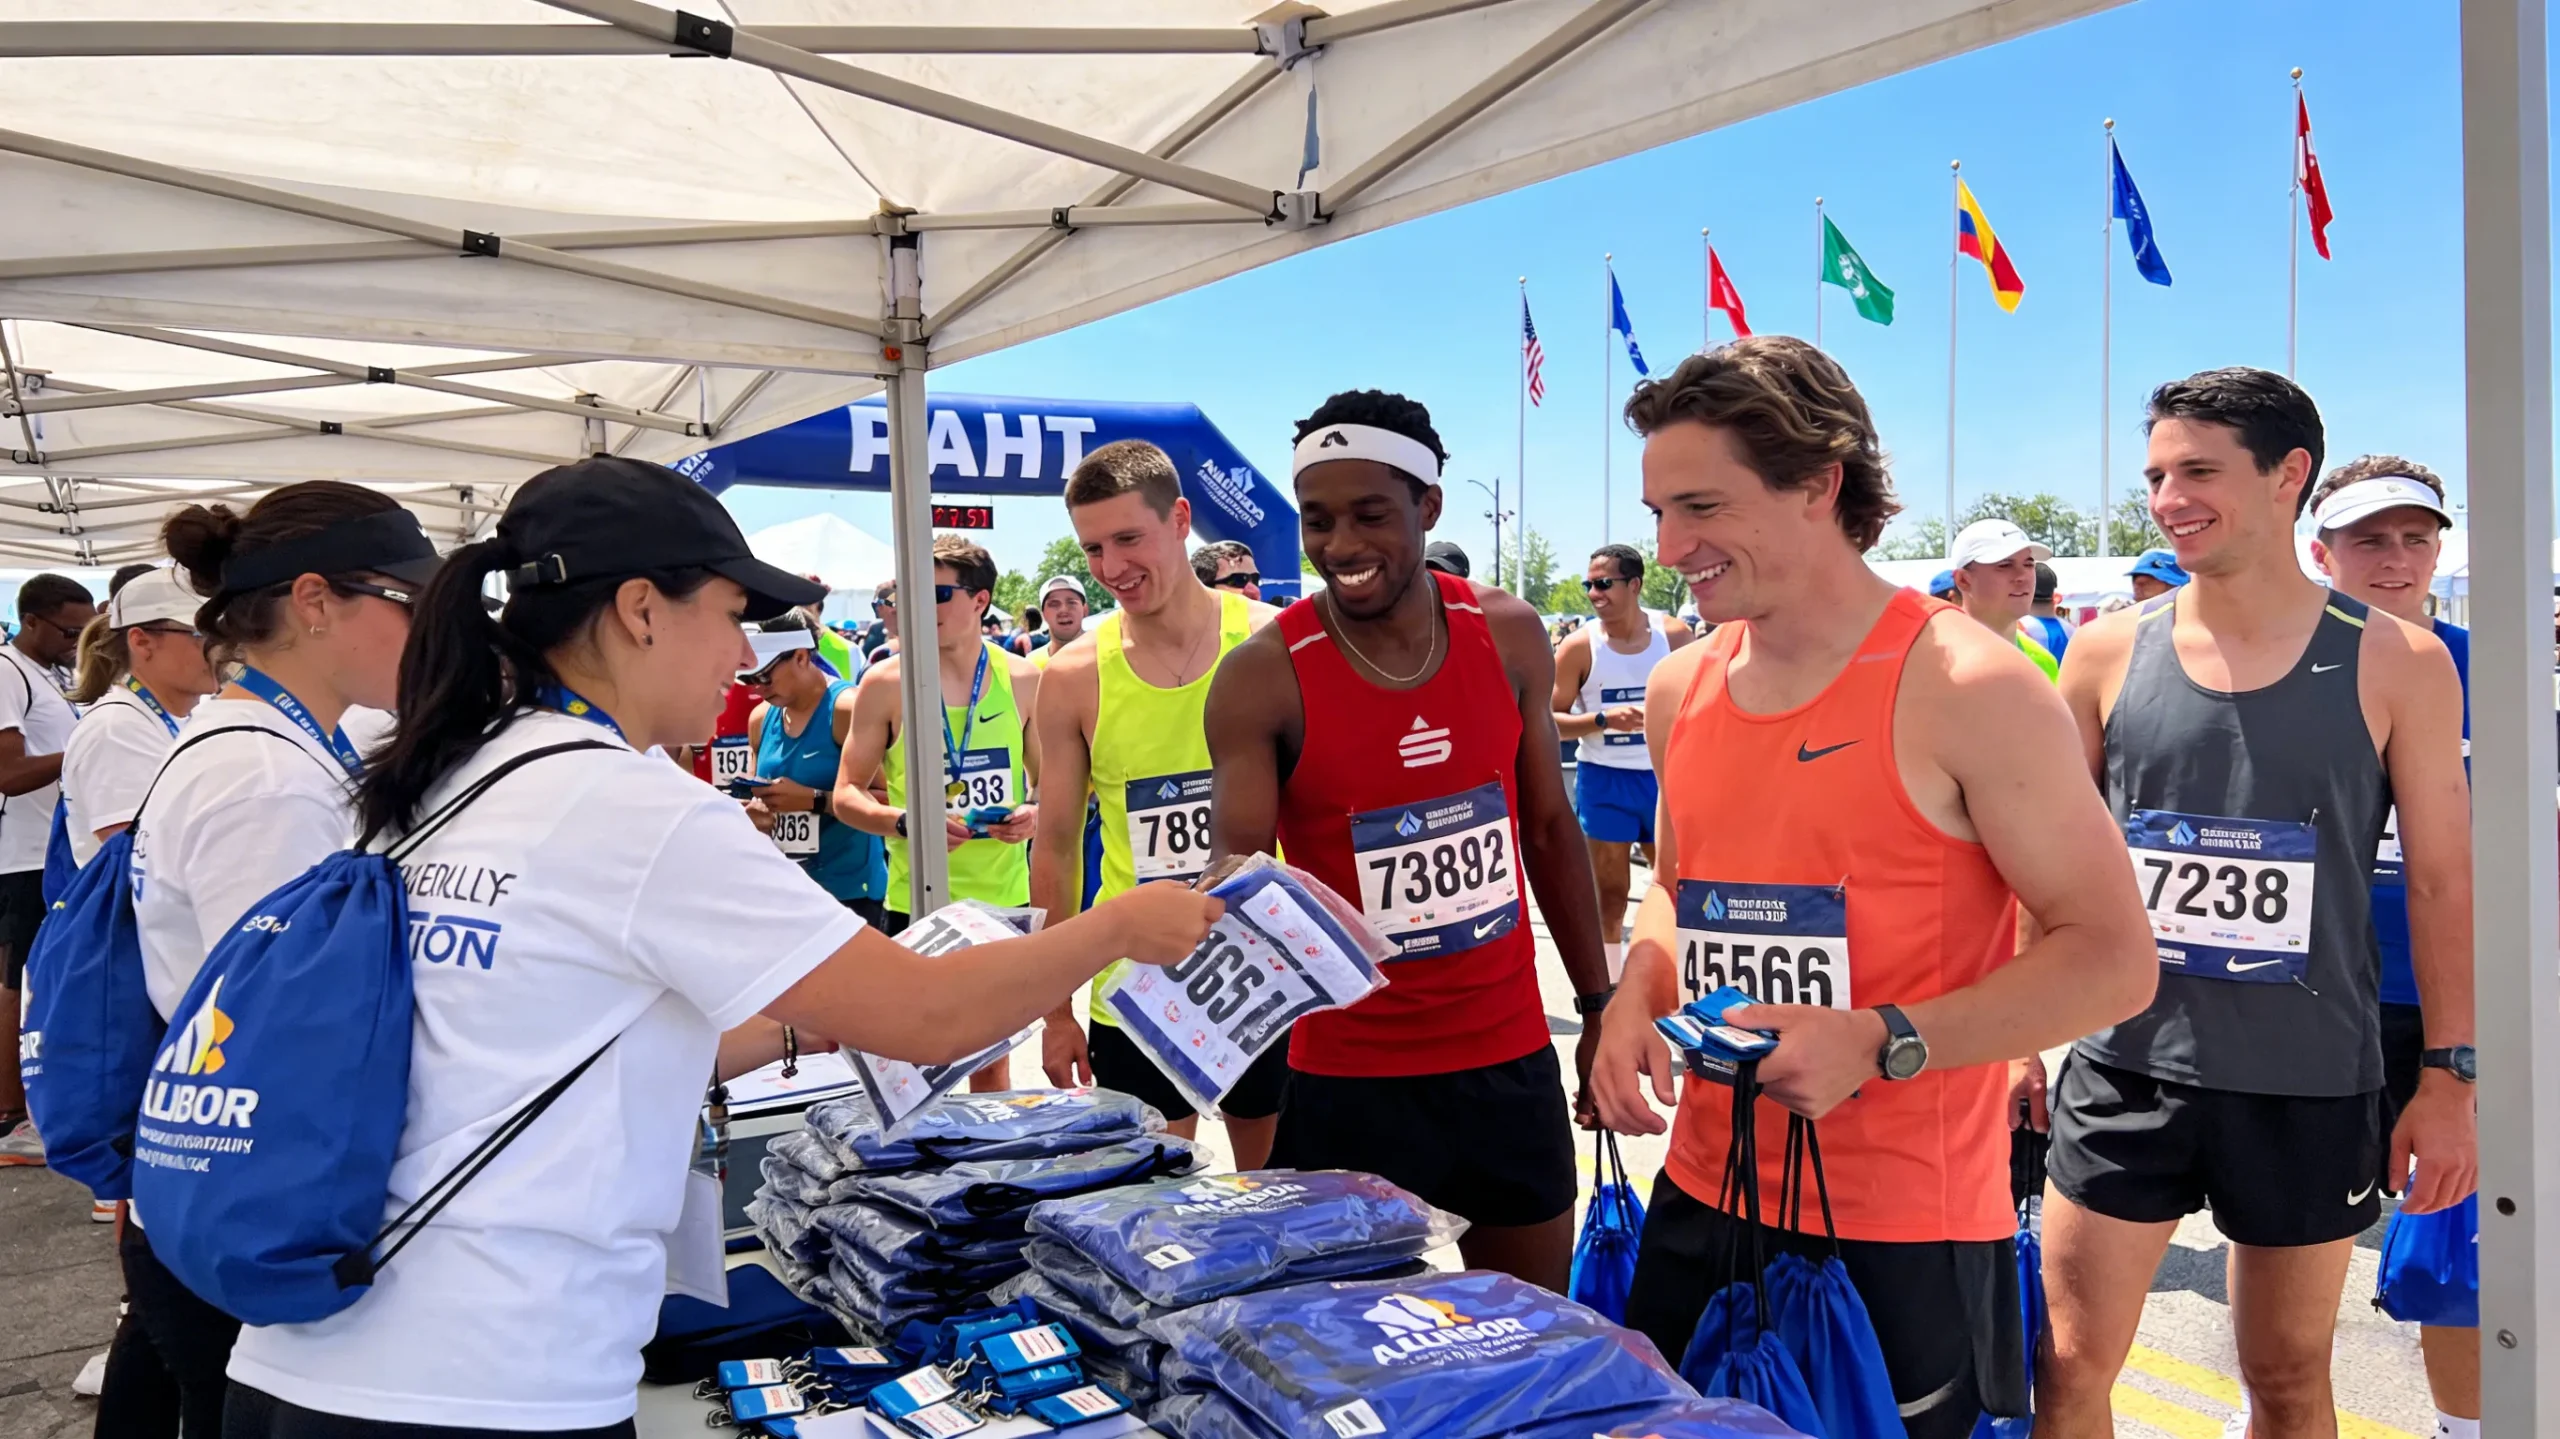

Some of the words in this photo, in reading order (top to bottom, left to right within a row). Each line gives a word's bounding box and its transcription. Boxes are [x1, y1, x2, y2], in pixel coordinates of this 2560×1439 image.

[1139, 806, 1212, 857] 788
[1369, 828, 1508, 911] 73892
[2144, 857, 2289, 924] 7238
[1684, 940, 1833, 1008] 45566
